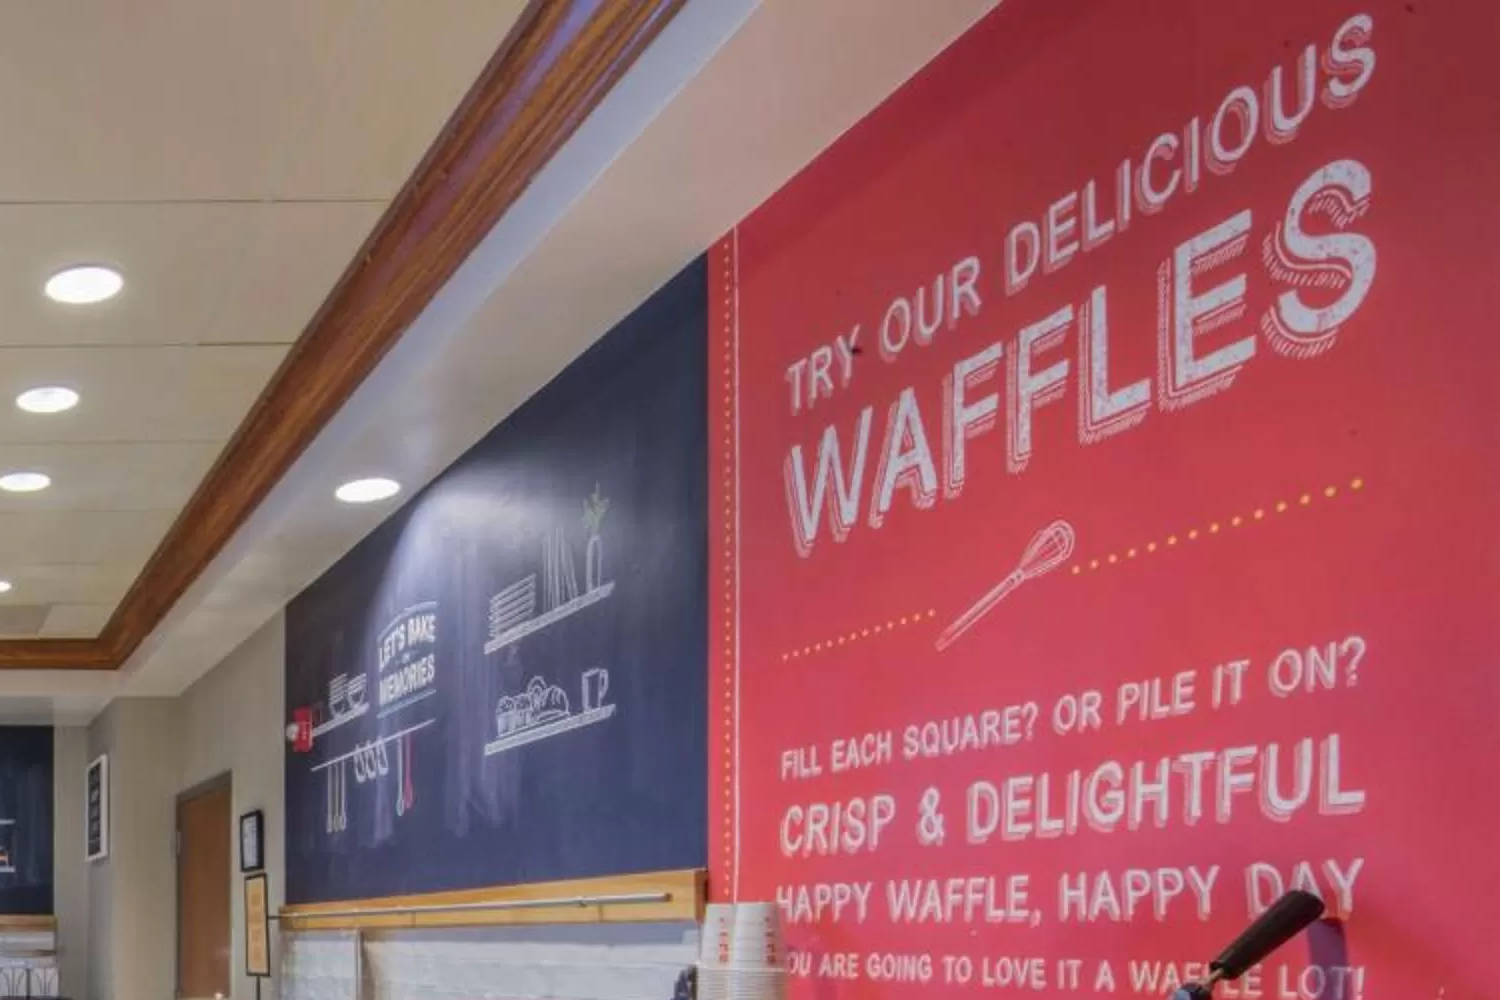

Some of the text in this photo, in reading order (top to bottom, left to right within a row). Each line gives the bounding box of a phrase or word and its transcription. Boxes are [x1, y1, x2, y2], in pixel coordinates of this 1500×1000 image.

[785, 12, 1377, 416] TRY OUR DELICIOUS
[783, 158, 1380, 558] WAFFLES
[781, 635, 1367, 781] FILL EACH SQUARE? OR PILE IT ON?
[780, 734, 1366, 857] CRISP & DELIGHTFUL
[776, 857, 1365, 928] HAPPY WAFFLE, HAPPY DAY
[786, 951, 812, 977] OU
[819, 952, 858, 979] ARE
[866, 952, 933, 982] GOING
[942, 955, 973, 983] TO
[982, 956, 1047, 990] LOVE
[1057, 958, 1083, 990] IT
[1094, 959, 1116, 992] A
